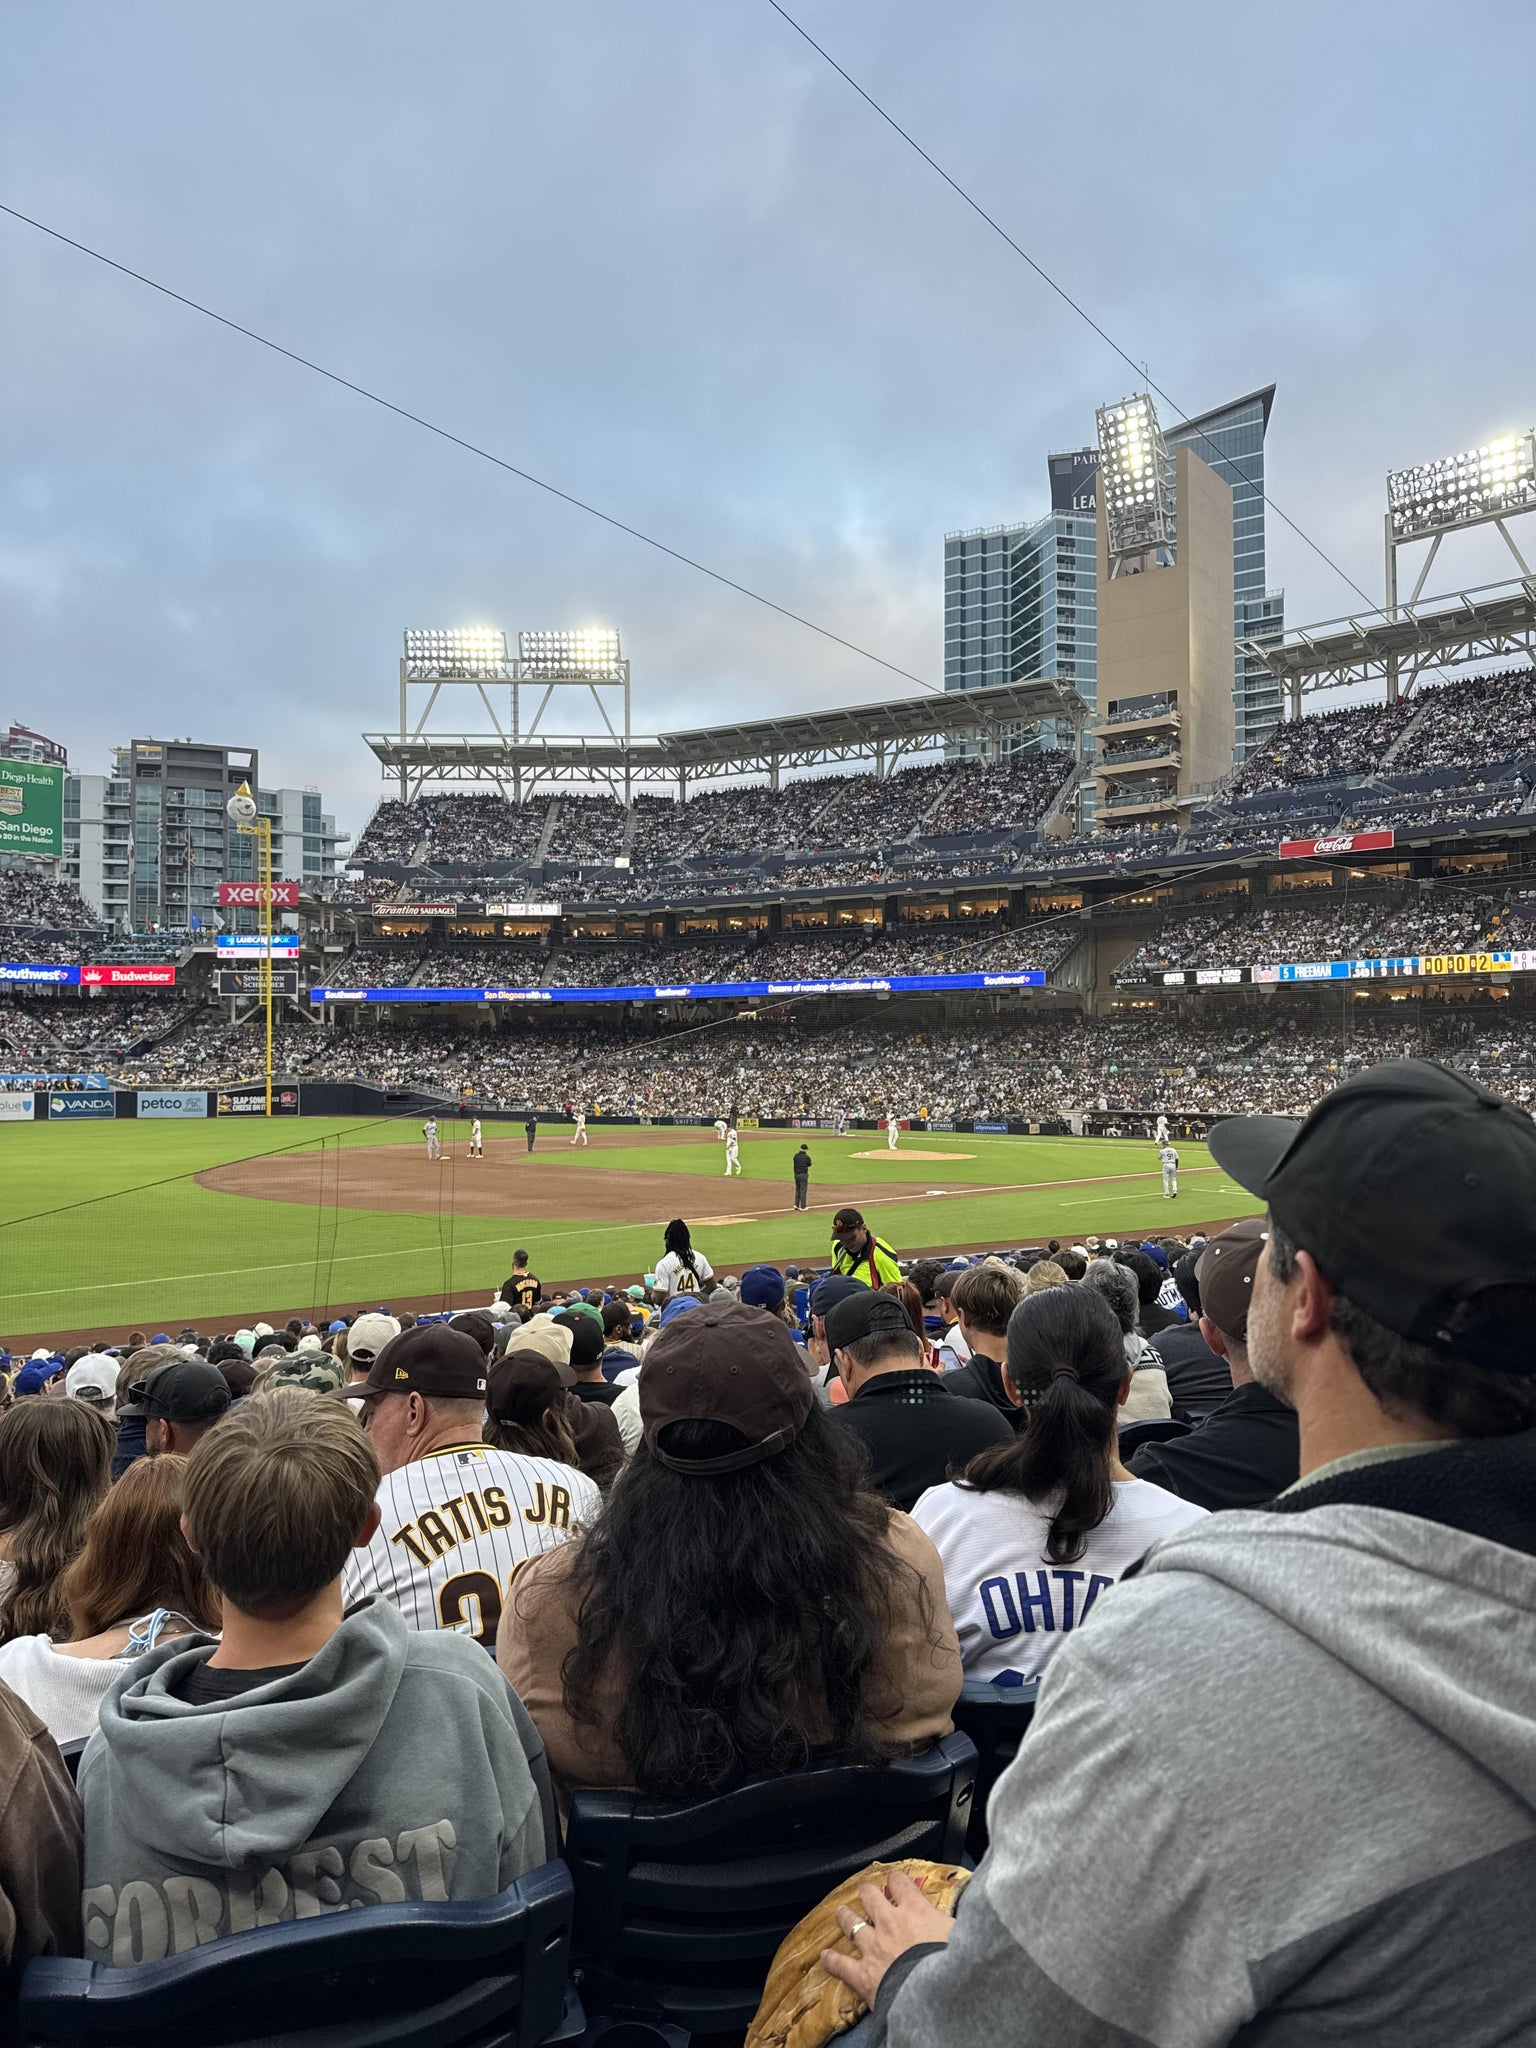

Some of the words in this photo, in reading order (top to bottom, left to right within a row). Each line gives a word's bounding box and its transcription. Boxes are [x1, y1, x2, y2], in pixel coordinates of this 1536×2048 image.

[2, 770, 26, 784] Diego
[27, 773, 54, 786] Health
[0, 787, 20, 796] BEST
[0, 821, 20, 832] San
[22, 823, 53, 836] Diego
[32, 836, 53, 844] Nation
[227, 888, 290, 903] xerox
[375, 904, 419, 915] Tarantino
[1435, 957, 1442, 972] 0
[1448, 960, 1454, 968] S
[1457, 956, 1465, 971] 0
[1480, 955, 1488, 970] 2
[0, 967, 60, 981] Southwest
[111, 971, 170, 981] Budweiser
[1283, 968, 1289, 979] 5
[1295, 966, 1331, 977] FREEMAN
[984, 976, 1025, 985] Southwest
[325, 991, 363, 999] Southwest
[655, 989, 686, 997] Southwest
[66, 1100, 113, 1109] VANDA
[142, 1097, 182, 1112] petco
[249, 1096, 266, 1104] SOME
[677, 1272, 694, 1292] 44
[522, 1290, 533, 1310] 13
[391, 1485, 512, 1568] TATIS
[524, 1481, 580, 1532] JR.
